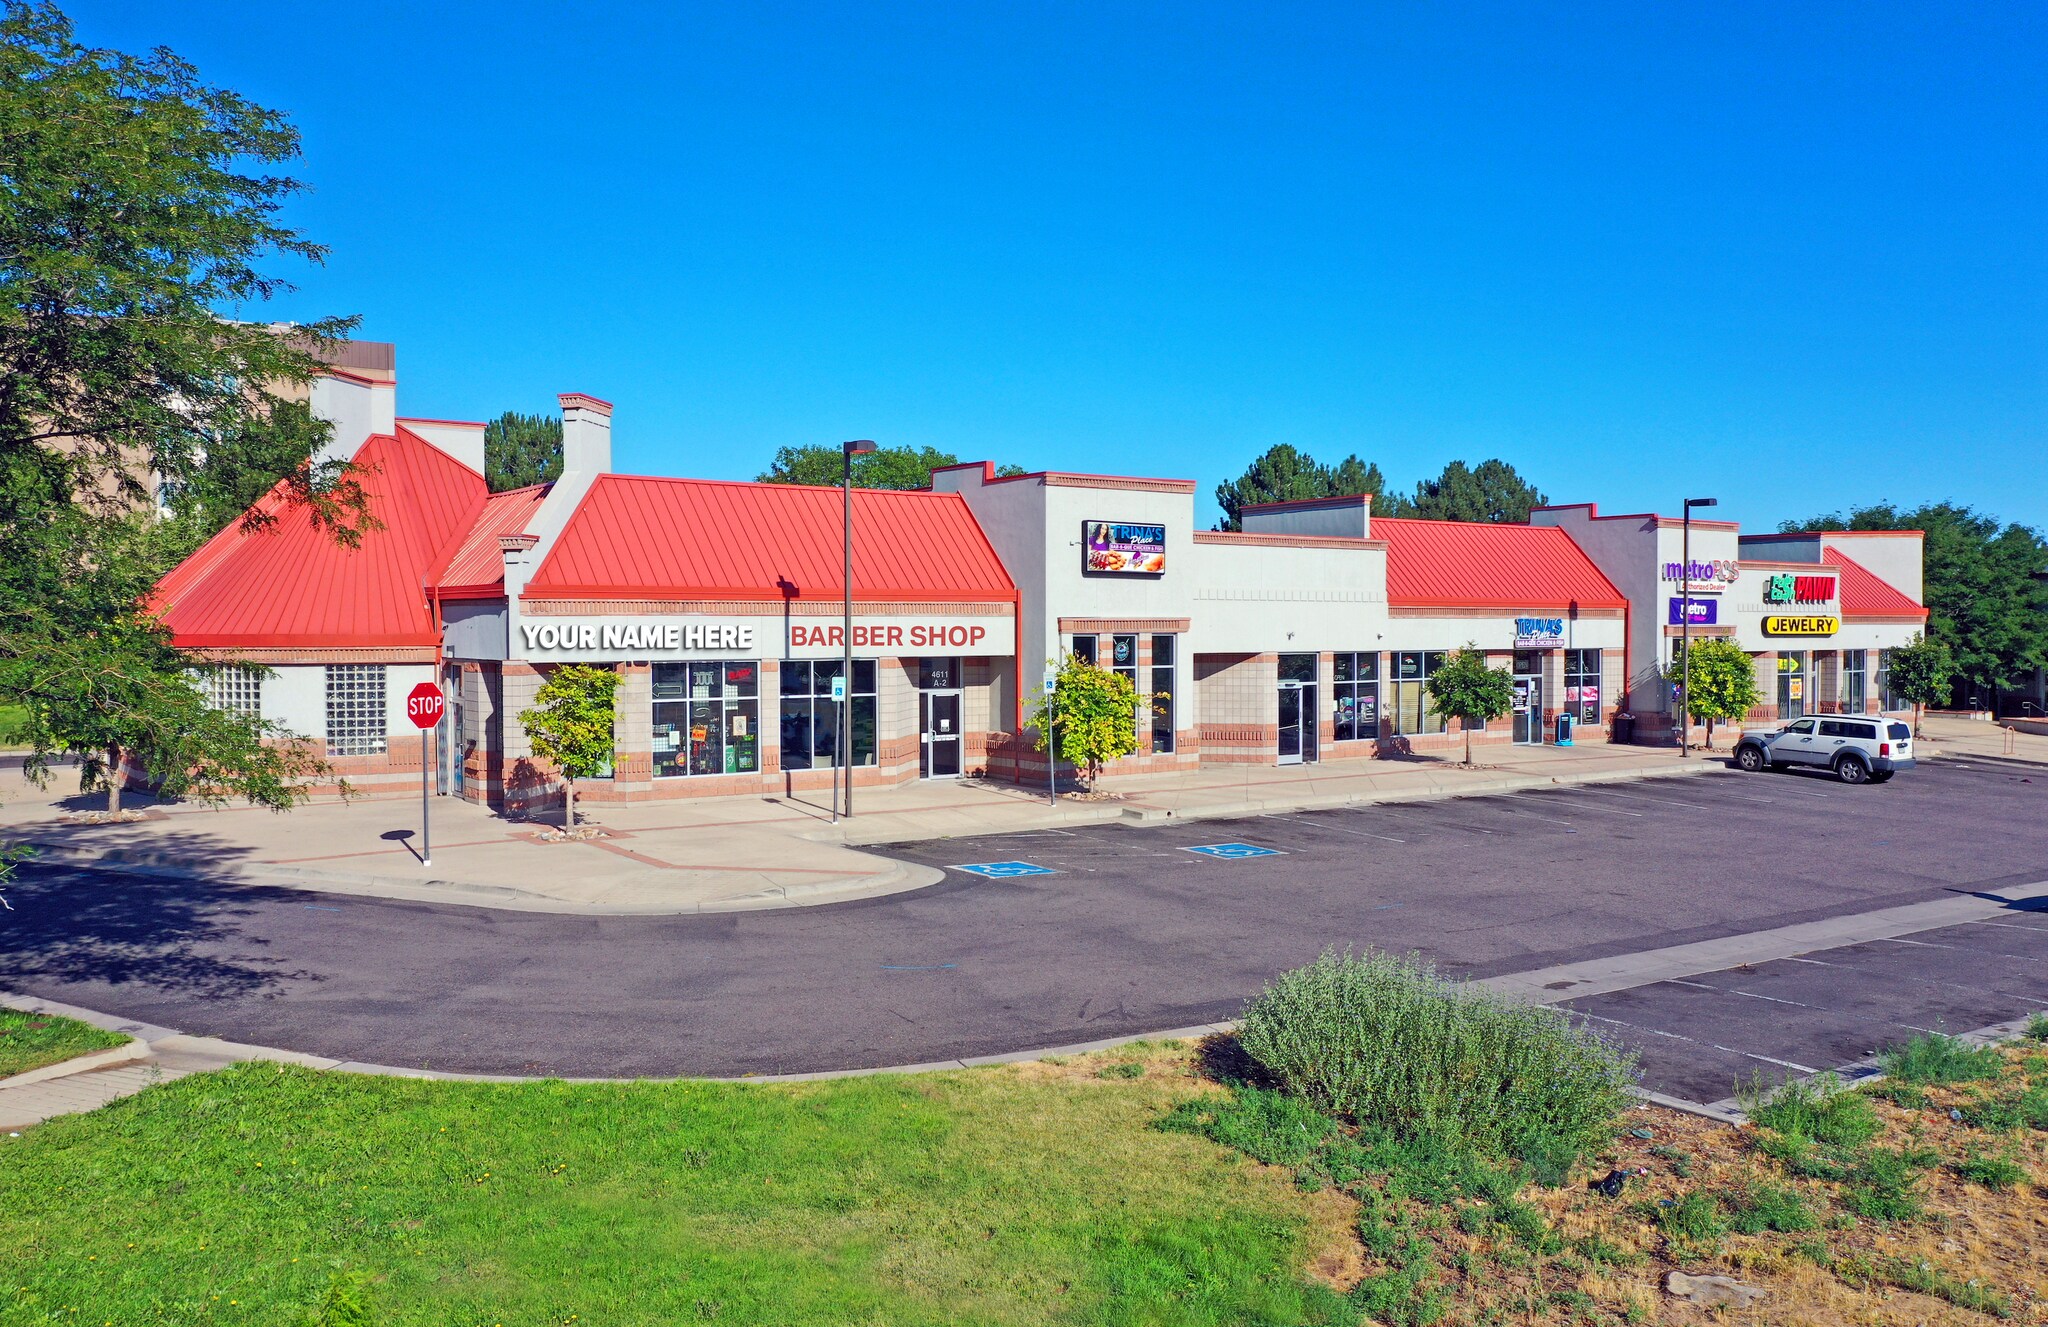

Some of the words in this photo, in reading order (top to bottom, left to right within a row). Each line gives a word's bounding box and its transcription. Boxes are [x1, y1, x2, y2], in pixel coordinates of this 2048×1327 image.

[1110, 525, 1163, 541] TRINA'S
[1130, 535, 1153, 545] Place
[1682, 583, 1709, 591] Athorized
[1796, 576, 1836, 600] PAWN
[1517, 618, 1563, 635] TRINA'S
[1772, 619, 1833, 631] JEWELRY
[521, 625, 597, 650] YOUR
[602, 625, 679, 650] NAME
[685, 625, 753, 649] HERE
[791, 625, 903, 647] BARBER
[910, 625, 986, 647] SHOP
[1531, 630, 1551, 640] Place
[931, 670, 949, 678] 4611
[409, 696, 443, 716] STOP
